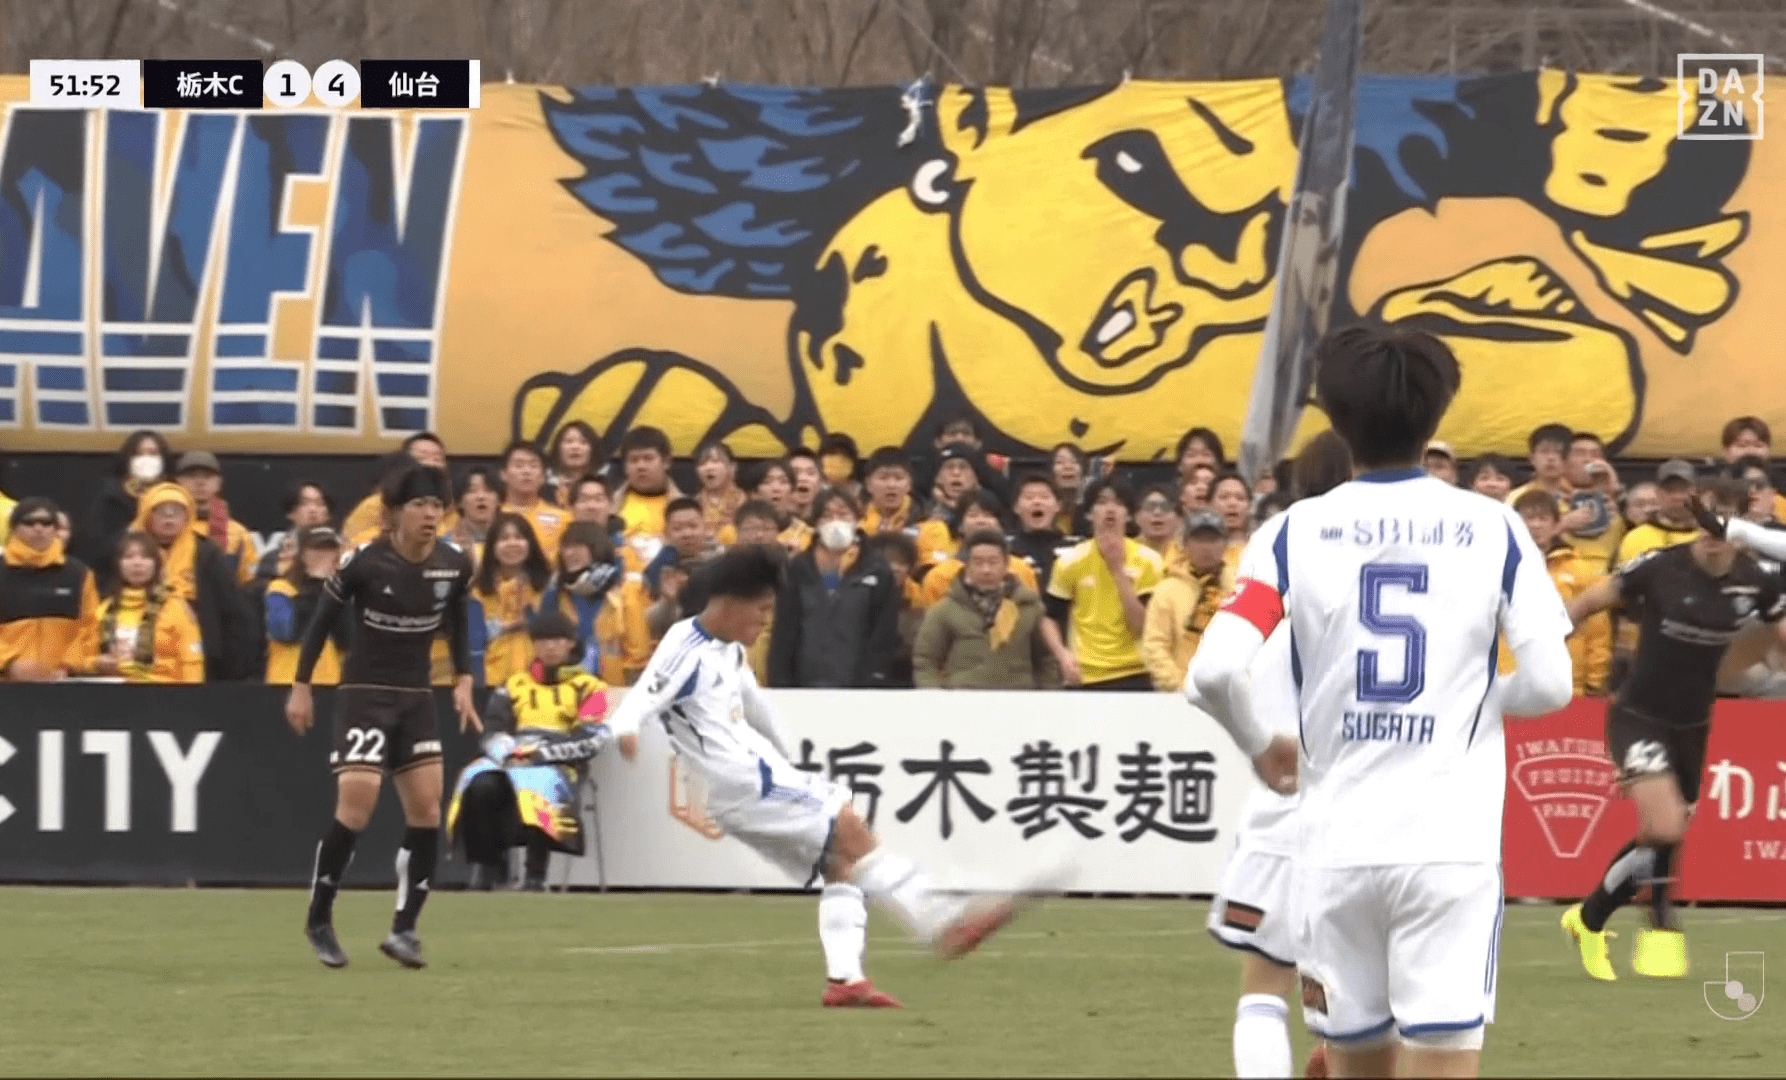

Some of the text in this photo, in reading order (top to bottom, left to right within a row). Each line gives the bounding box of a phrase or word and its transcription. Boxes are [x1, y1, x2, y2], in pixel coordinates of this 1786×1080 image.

[1356, 563, 1428, 704] 5
[1342, 711, 1436, 743] SUGATA
[345, 727, 386, 762] 22
[0, 729, 223, 832] ITY
[1528, 767, 1611, 787] FRUITS
[1542, 803, 1594, 818] PARK
